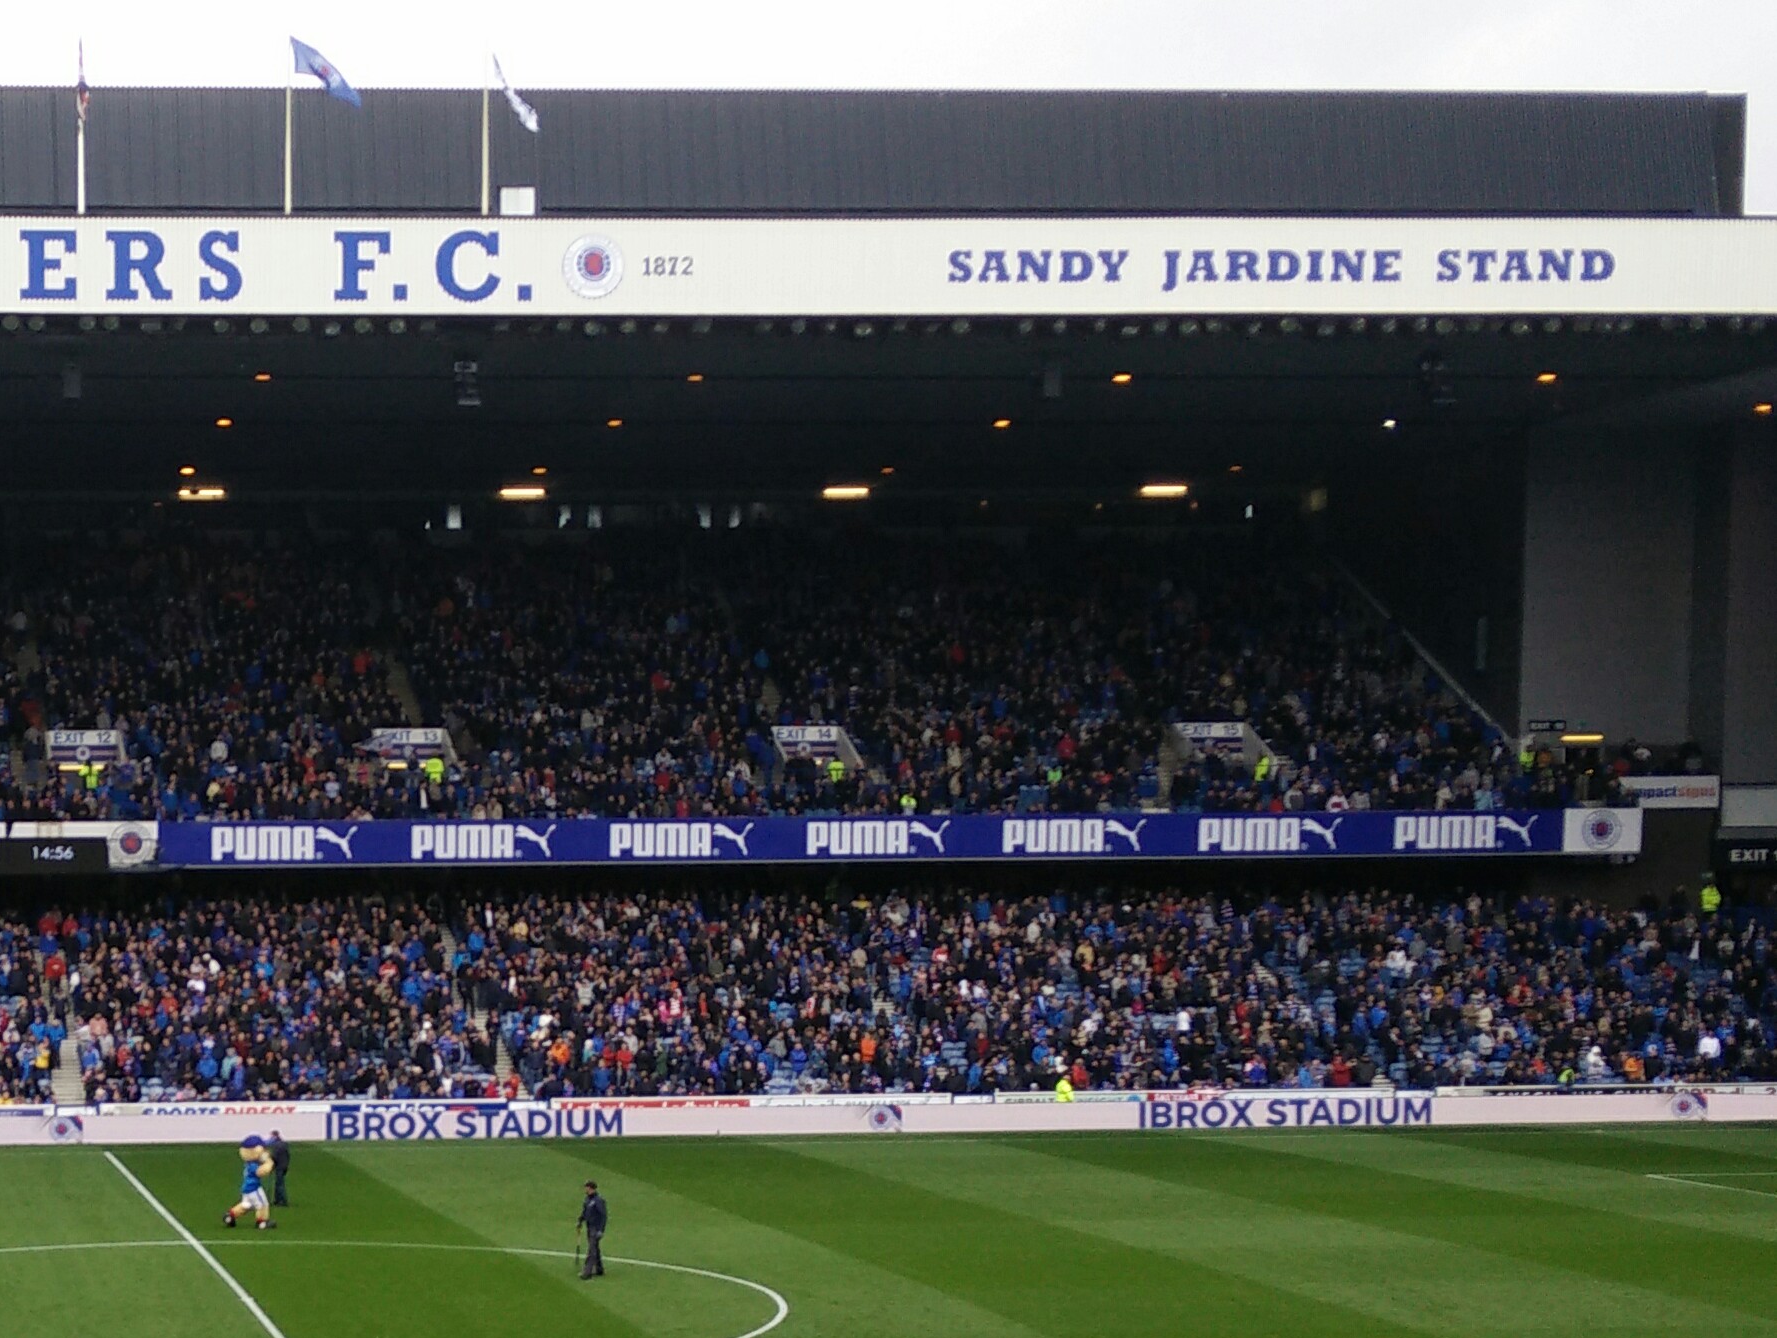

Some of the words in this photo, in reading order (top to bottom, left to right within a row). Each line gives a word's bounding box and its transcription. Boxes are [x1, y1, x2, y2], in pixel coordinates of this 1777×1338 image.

[333, 231, 533, 302] F.C.
[641, 256, 693, 277] 1872
[947, 249, 1129, 283] SANDY
[1162, 250, 1402, 292] JARDINE
[1436, 249, 1616, 283] STAND
[52, 732, 89, 744] EXIT
[96, 732, 111, 744] 12
[381, 730, 411, 741] XIT
[424, 731, 438, 741] 13
[776, 728, 807, 739] EXIT
[817, 728, 832, 739] 14
[212, 827, 314, 861] PUMA
[412, 825, 514, 859] PUMA
[610, 823, 711, 857] PUMA
[807, 821, 908, 855] PUMA
[1003, 820, 1104, 853] PUMA
[1200, 819, 1300, 852] PUMA
[1396, 817, 1494, 849] PUMA
[31, 845, 74, 861] 14:56
[1729, 849, 1769, 861] EXIT
[326, 1112, 442, 1139] IBROX
[456, 1108, 622, 1137] STADIUM
[1139, 1100, 1253, 1128] IBROX
[1266, 1098, 1431, 1125] STADIUM
